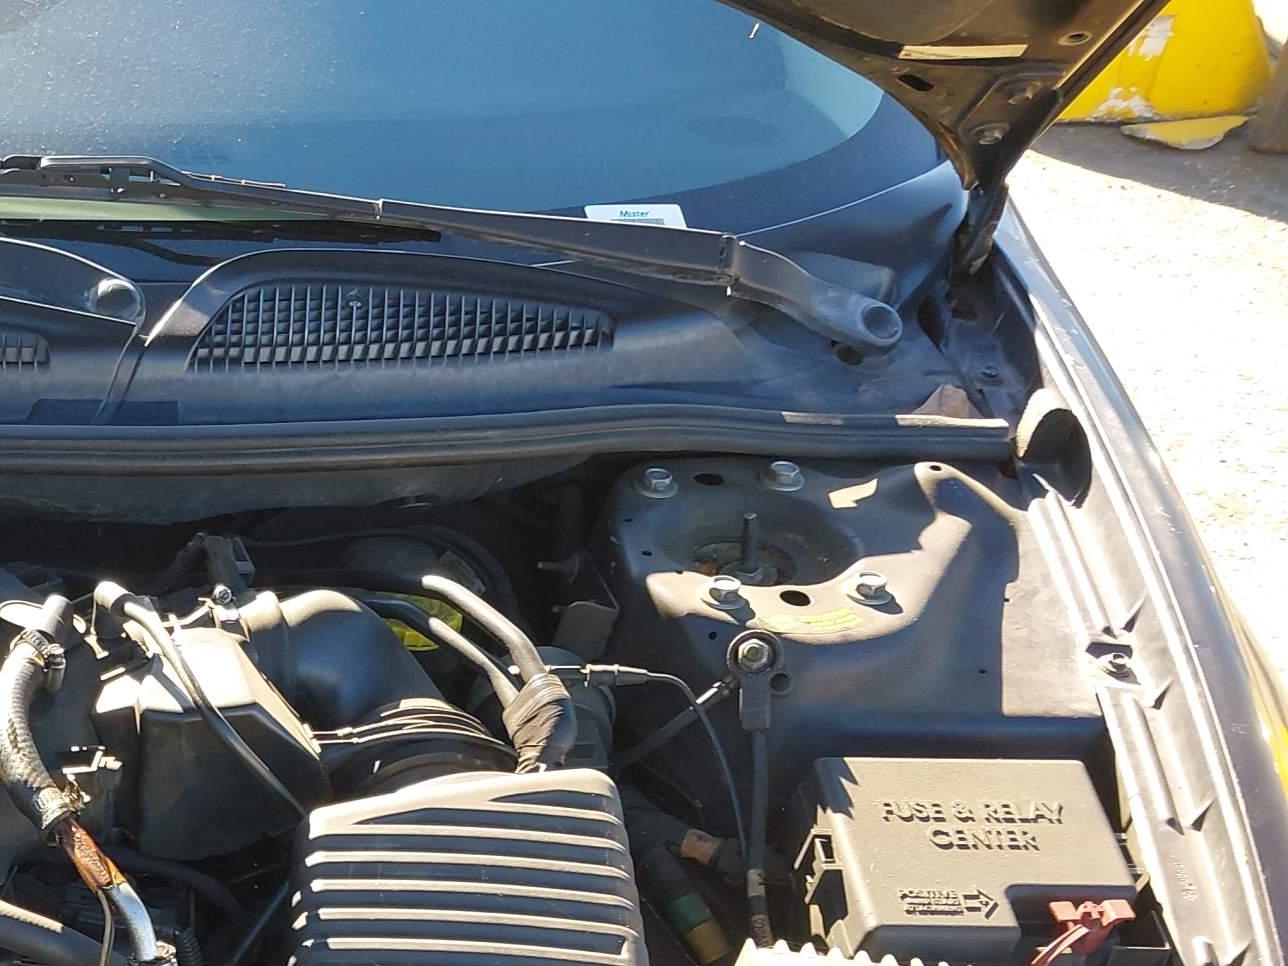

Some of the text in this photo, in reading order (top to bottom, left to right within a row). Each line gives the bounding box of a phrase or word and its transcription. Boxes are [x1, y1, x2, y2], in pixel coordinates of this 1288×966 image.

[880, 800, 1064, 824] FUSE & RELAY
[929, 828, 1040, 851] CENTER
[898, 888, 959, 901] POSITIVE
